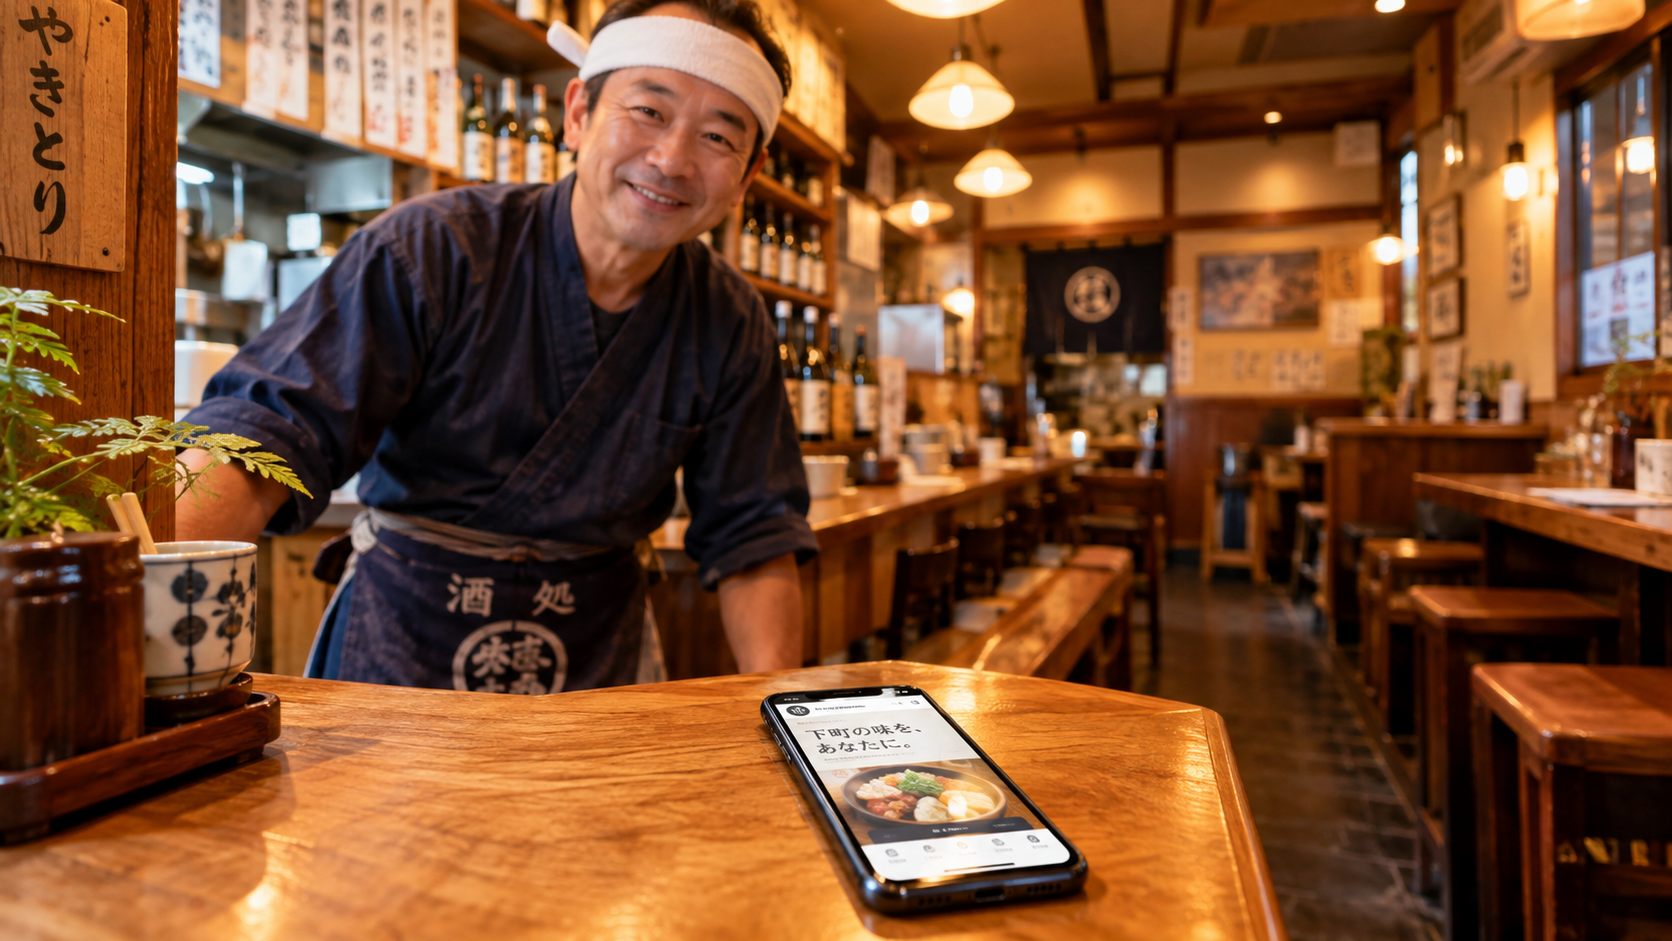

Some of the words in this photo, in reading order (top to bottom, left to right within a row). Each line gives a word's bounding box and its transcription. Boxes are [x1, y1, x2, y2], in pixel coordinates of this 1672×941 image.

[18, 5, 73, 235] やきとり
[446, 573, 576, 617] 酒処
[805, 723, 922, 740] 下町の味を、
[817, 739, 911, 754] あなたに。
